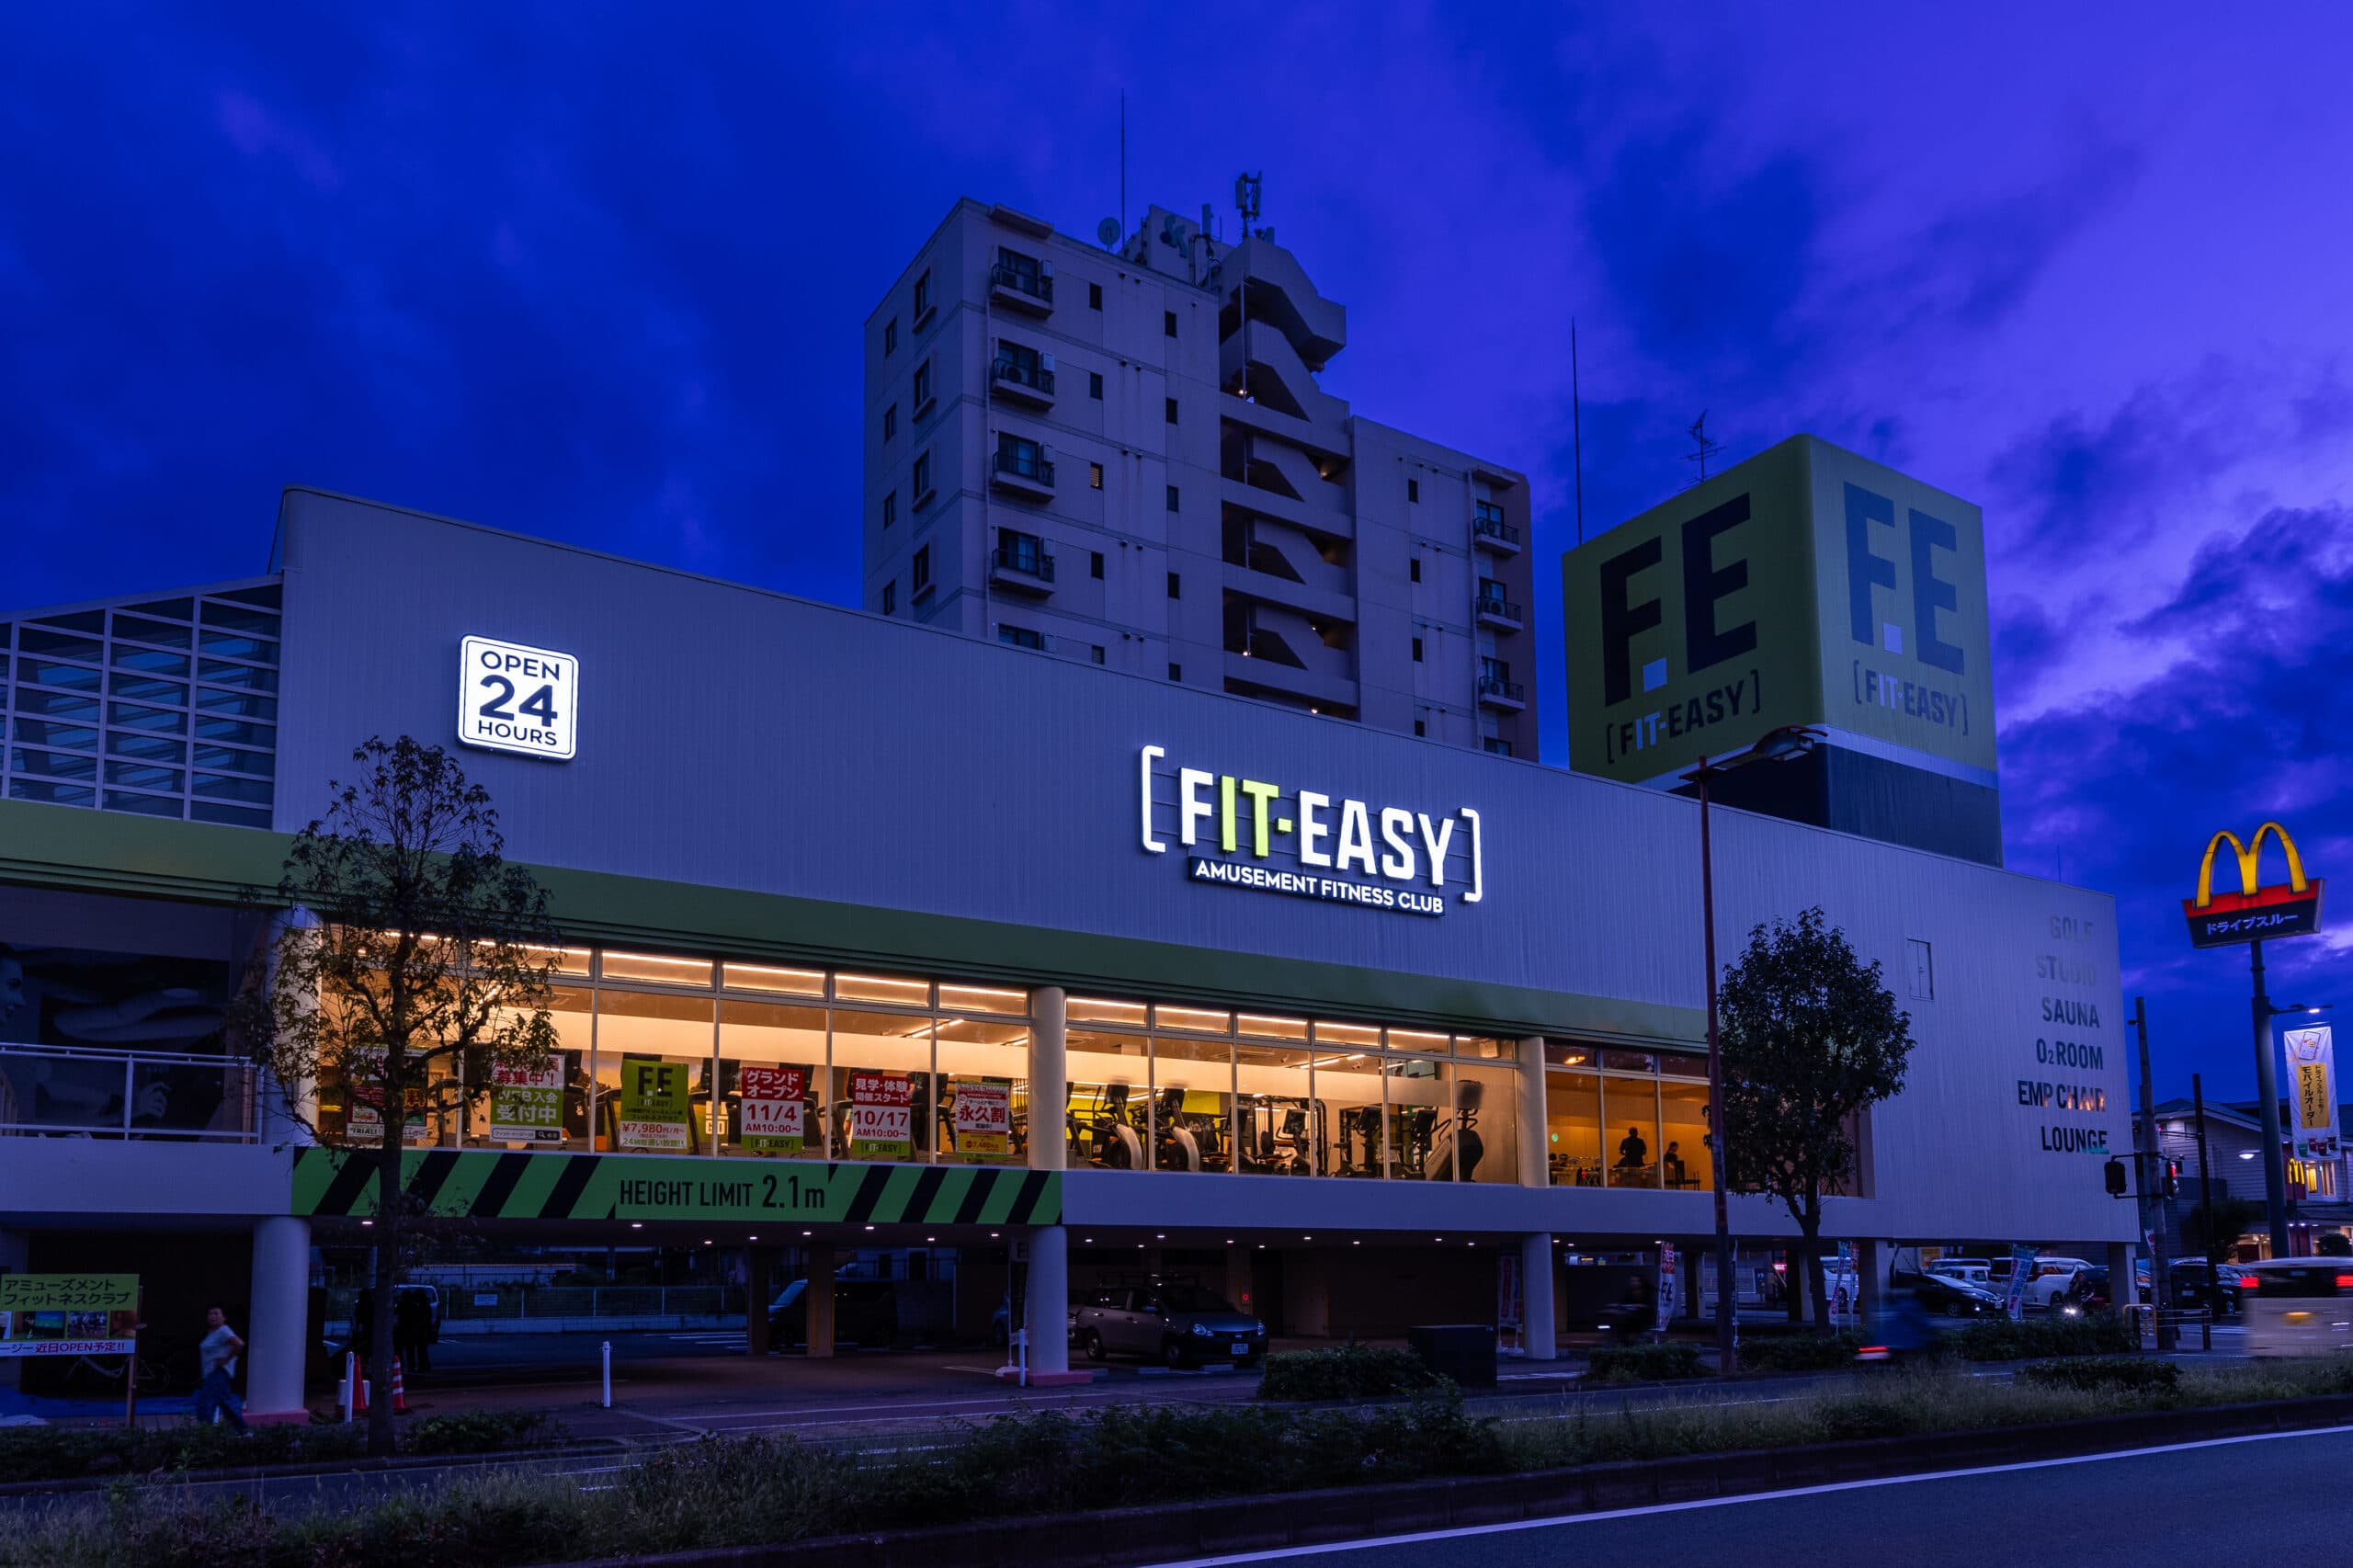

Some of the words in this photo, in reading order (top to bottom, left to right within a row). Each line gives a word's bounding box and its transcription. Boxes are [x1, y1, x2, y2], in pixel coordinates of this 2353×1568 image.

[481, 651, 560, 681] OPEN
[480, 675, 558, 727] 24
[478, 720, 557, 745] HOURS
[1195, 859, 1318, 894] AMUSEMENT
[1321, 879, 1394, 907] FITNESS
[1398, 892, 1444, 915] CLUB
[2050, 915, 2094, 943] GOLF
[2206, 914, 2298, 935] ドライブスルー
[2036, 954, 2098, 987] STUDIO
[2041, 996, 2101, 1028] SAUNA
[747, 1070, 799, 1085] グランド
[747, 1085, 800, 1099] オープン
[856, 1092, 907, 1103] 開催スタート
[2018, 1080, 2053, 1108] EMP
[2056, 1084, 2106, 1113] CHAIR
[2302, 1066, 2315, 1127] モバイルオーダー
[497, 1104, 557, 1123] 受付中
[747, 1103, 797, 1121] 11/4
[854, 1109, 908, 1127] 10/17
[960, 1105, 1005, 1123] 永久割
[2040, 1126, 2110, 1155] LOUNGE
[620, 1179, 693, 1206] HEIGHT
[699, 1182, 754, 1207] LIMIT
[5, 1278, 116, 1291] アミューズメント
[5, 1292, 131, 1305] フィットネスクラブ
